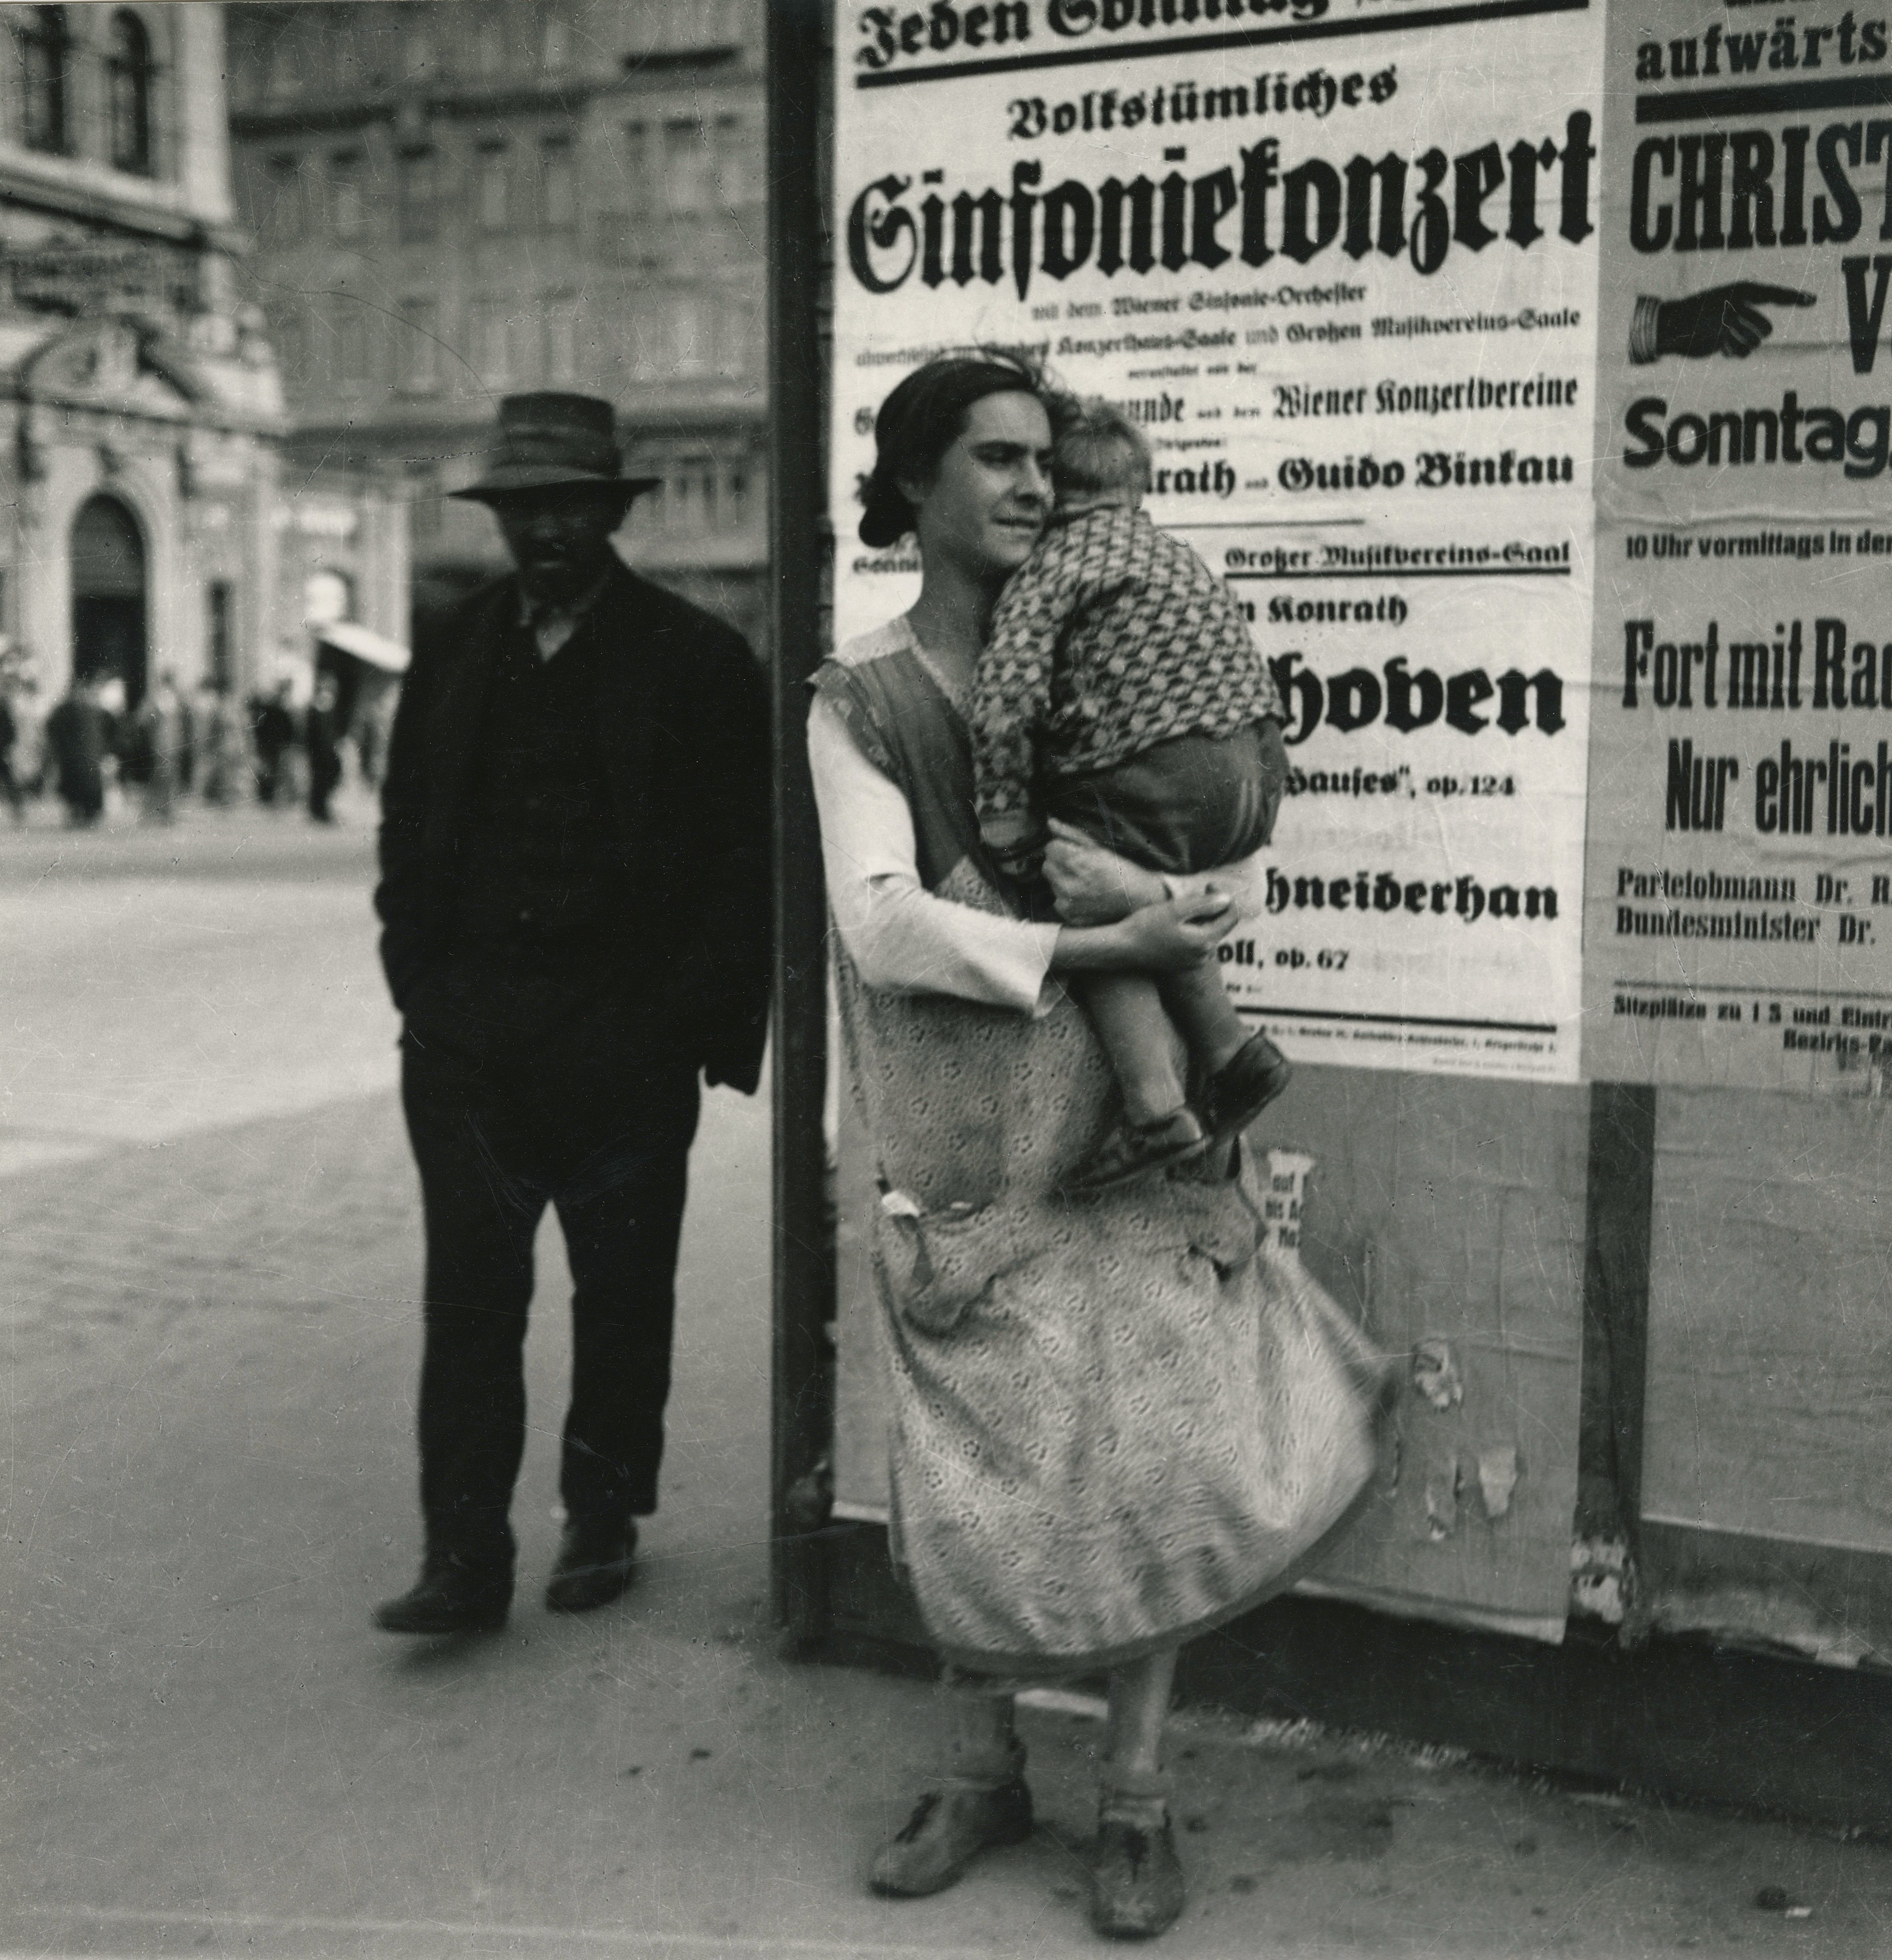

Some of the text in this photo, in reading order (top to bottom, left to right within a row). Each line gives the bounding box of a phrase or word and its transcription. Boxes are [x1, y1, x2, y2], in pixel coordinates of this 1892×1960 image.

[856, 1, 1031, 69] Jeden
[1635, 10, 1890, 83] aufwärts
[1003, 62, 1398, 141] Volkstümliches
[846, 108, 1597, 305] Sinfoniekonzert
[1112, 296, 1180, 316] Wiener
[1274, 385, 1368, 418] Wiener
[1375, 374, 1578, 416] Konzertvereine
[1623, 390, 1892, 480] Sonntag
[1146, 458, 1238, 500] rath
[1277, 455, 1405, 492] Guido
[1415, 450, 1573, 488] Binkau
[1627, 535, 1648, 559] 10
[1652, 533, 1692, 558] Uhr
[1698, 531, 1825, 560] vormittags
[1829, 530, 1852, 554] in
[1268, 595, 1408, 625] Konrath
[1622, 619, 1719, 709] Fort
[1727, 619, 1803, 710] mit
[1265, 651, 1566, 747] hoven
[1665, 738, 1739, 832] Nur
[1265, 866, 1558, 923] hneiderhan
[1617, 868, 1795, 903] Parteiobmann
[1815, 873, 1852, 904] Dr.
[1616, 905, 1875, 944] Bundesminister Dr.
[1216, 937, 1265, 972] oll,
[1614, 994, 1707, 1020] Sitzplätze
[1717, 1004, 1741, 1021] zu
[1793, 1006, 1831, 1026] und
[1841, 1006, 1892, 1031] Eintr
